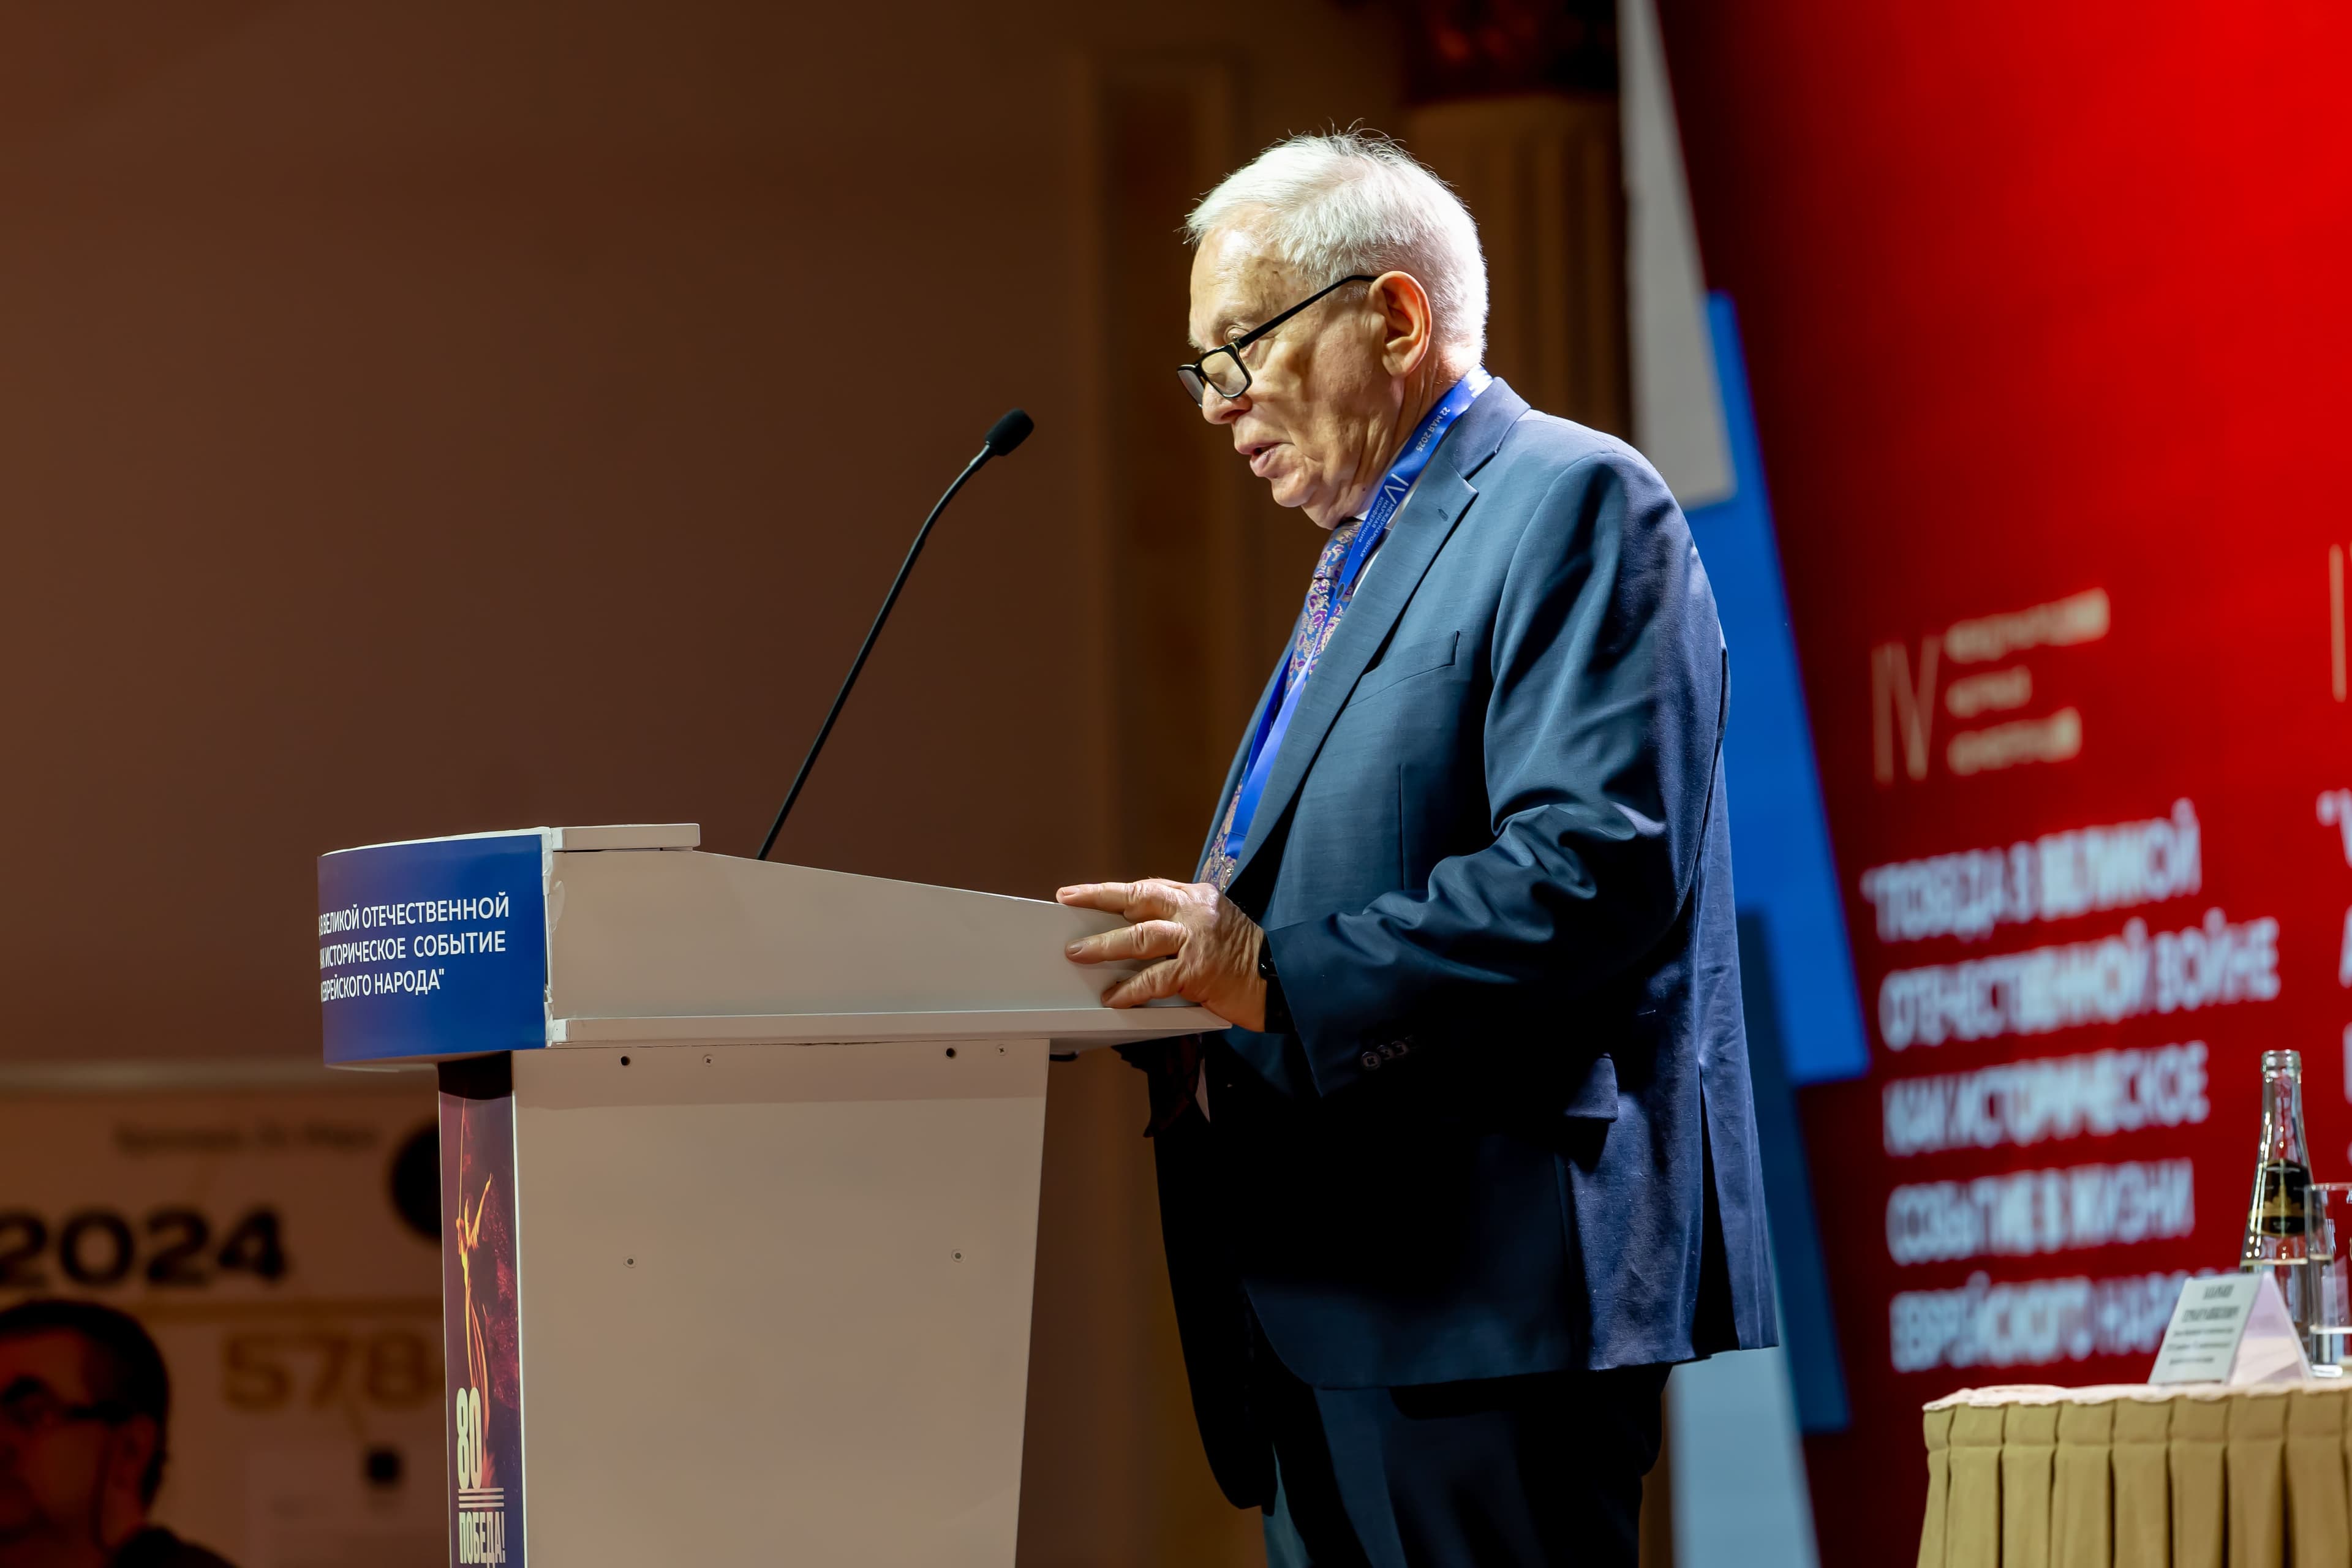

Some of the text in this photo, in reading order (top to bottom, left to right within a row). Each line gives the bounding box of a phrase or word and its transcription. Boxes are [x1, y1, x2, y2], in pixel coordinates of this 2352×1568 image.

[1415, 407, 1451, 452] 22 МАЯ 2025
[1384, 473, 1409, 505] IV
[1358, 496, 1384, 543] КОНФЕРЕНЦИЯ
[1360, 503, 1395, 557] МЕЖДУНАРОДНАЯ
[1372, 499, 1389, 529] НАУЧНАЯ
[323, 903, 360, 935] ВЕЛИКОЙ
[362, 891, 509, 929] ОТЕЧЕСТВЕННОЙ
[325, 938, 406, 968] ИСТОРИЧЕСКОЕ
[413, 930, 506, 957] СОБЫТИЕ
[375, 968, 445, 995] НАРОДА"
[0, 1207, 287, 1287] 2024
[456, 1387, 482, 1490] 80
[459, 1511, 505, 1568] ПОБЕДА!
